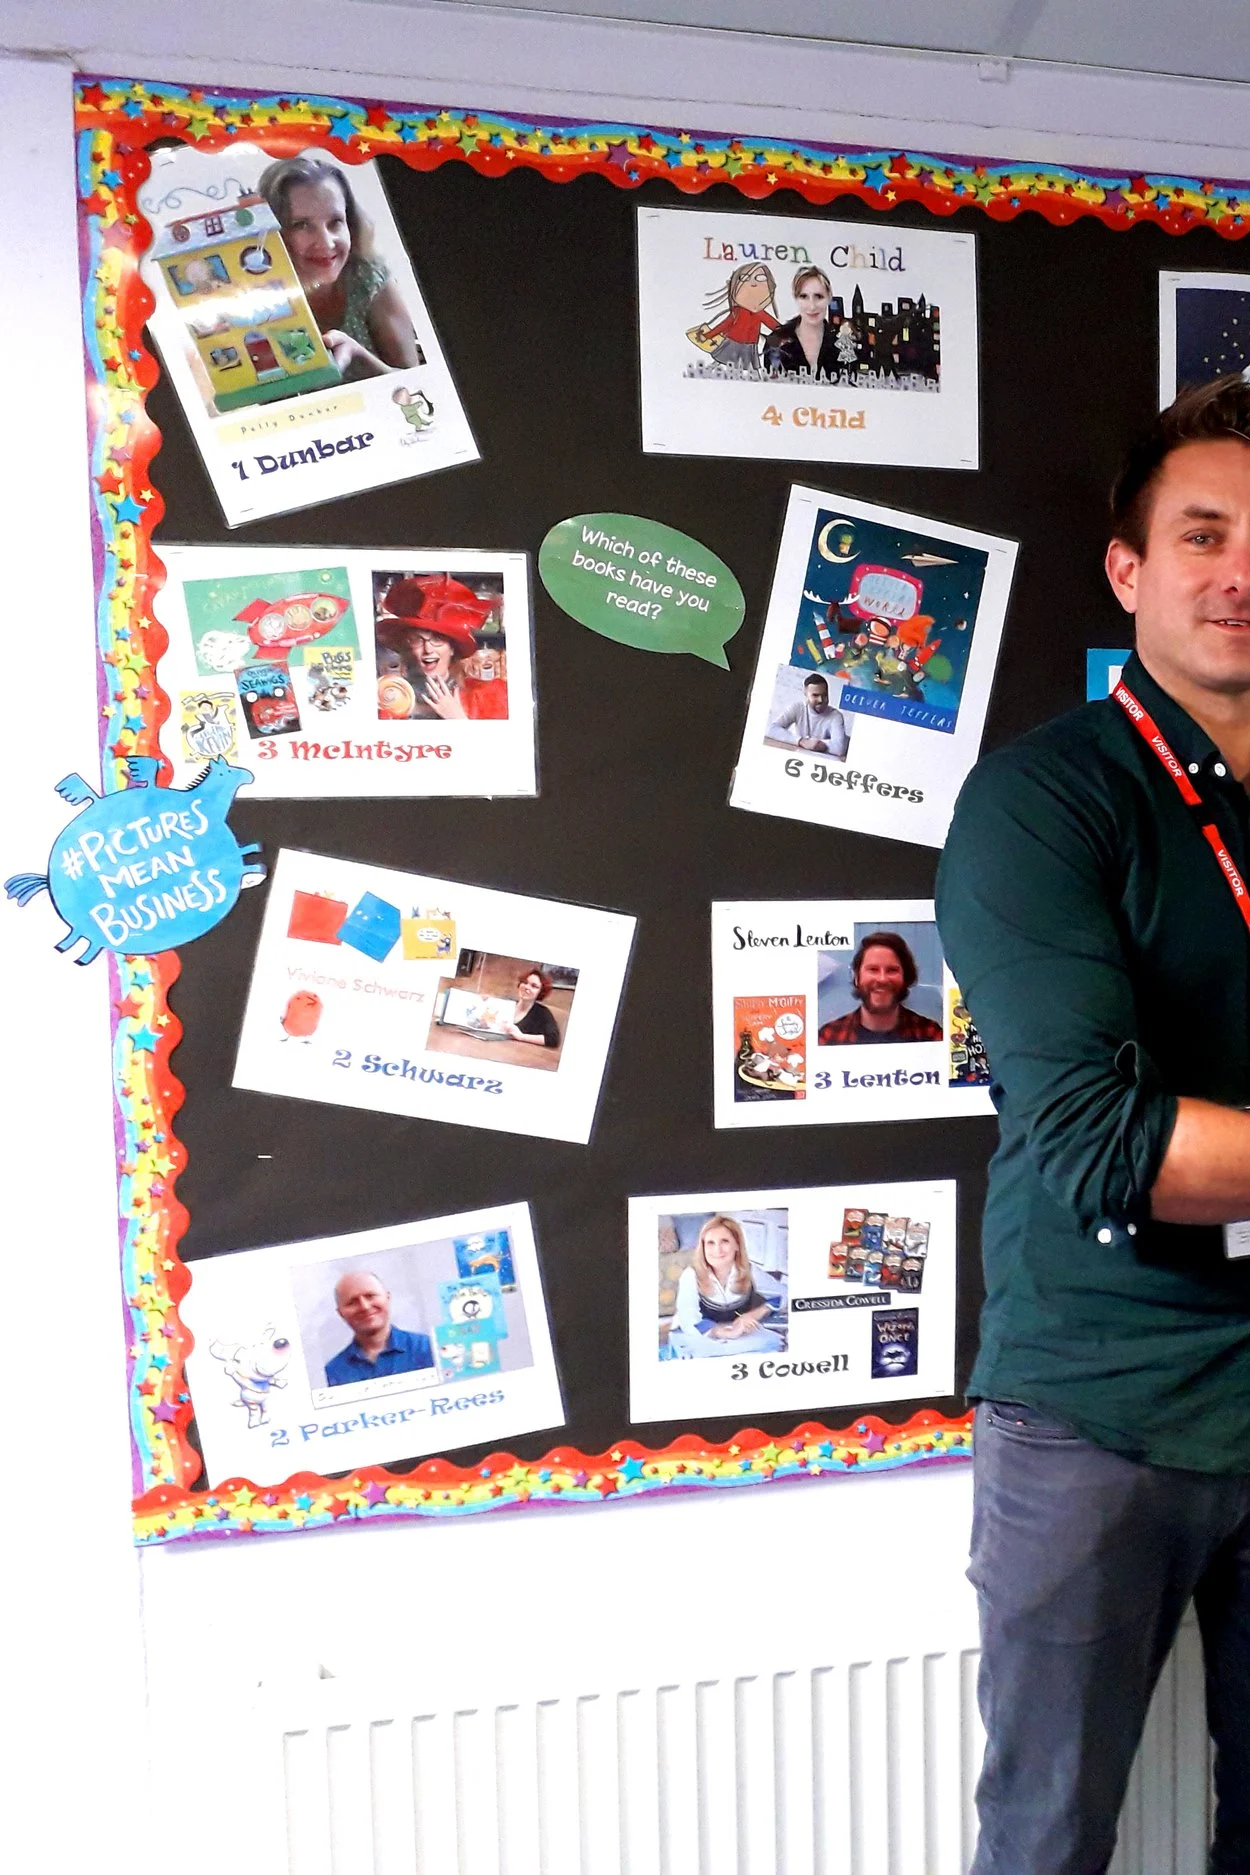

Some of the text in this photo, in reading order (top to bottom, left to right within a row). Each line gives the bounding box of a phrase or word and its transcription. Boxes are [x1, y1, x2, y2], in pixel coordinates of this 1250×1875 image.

[703, 236, 906, 273] Lauren Child
[289, 404, 338, 422] Dunbar
[760, 404, 866, 430] 4 Child
[231, 460, 250, 480] 1
[253, 431, 375, 475] Dunbar
[581, 525, 718, 588] Which of these
[571, 549, 710, 613] books have you
[605, 590, 663, 620] read?
[1115, 686, 1144, 722] VISITOR
[257, 740, 453, 763] 3 McIntyre
[1151, 735, 1183, 778] VISITOR
[784, 758, 924, 804] 6 Jeffers
[98, 845, 196, 899] MEAN
[1217, 849, 1244, 897] VISITOR
[89, 868, 227, 947] BUSINESS
[733, 924, 850, 950] Steven Lenton
[286, 966, 425, 1004] Viviane Schwarz
[331, 1048, 504, 1095] 2 Schwarz
[814, 1069, 941, 1089] 3 Lenton
[795, 1295, 886, 1310] CRESSIDA COWELL
[730, 1354, 849, 1380] 3 Cowell
[270, 1389, 506, 1447] 2 Parker-Rees
